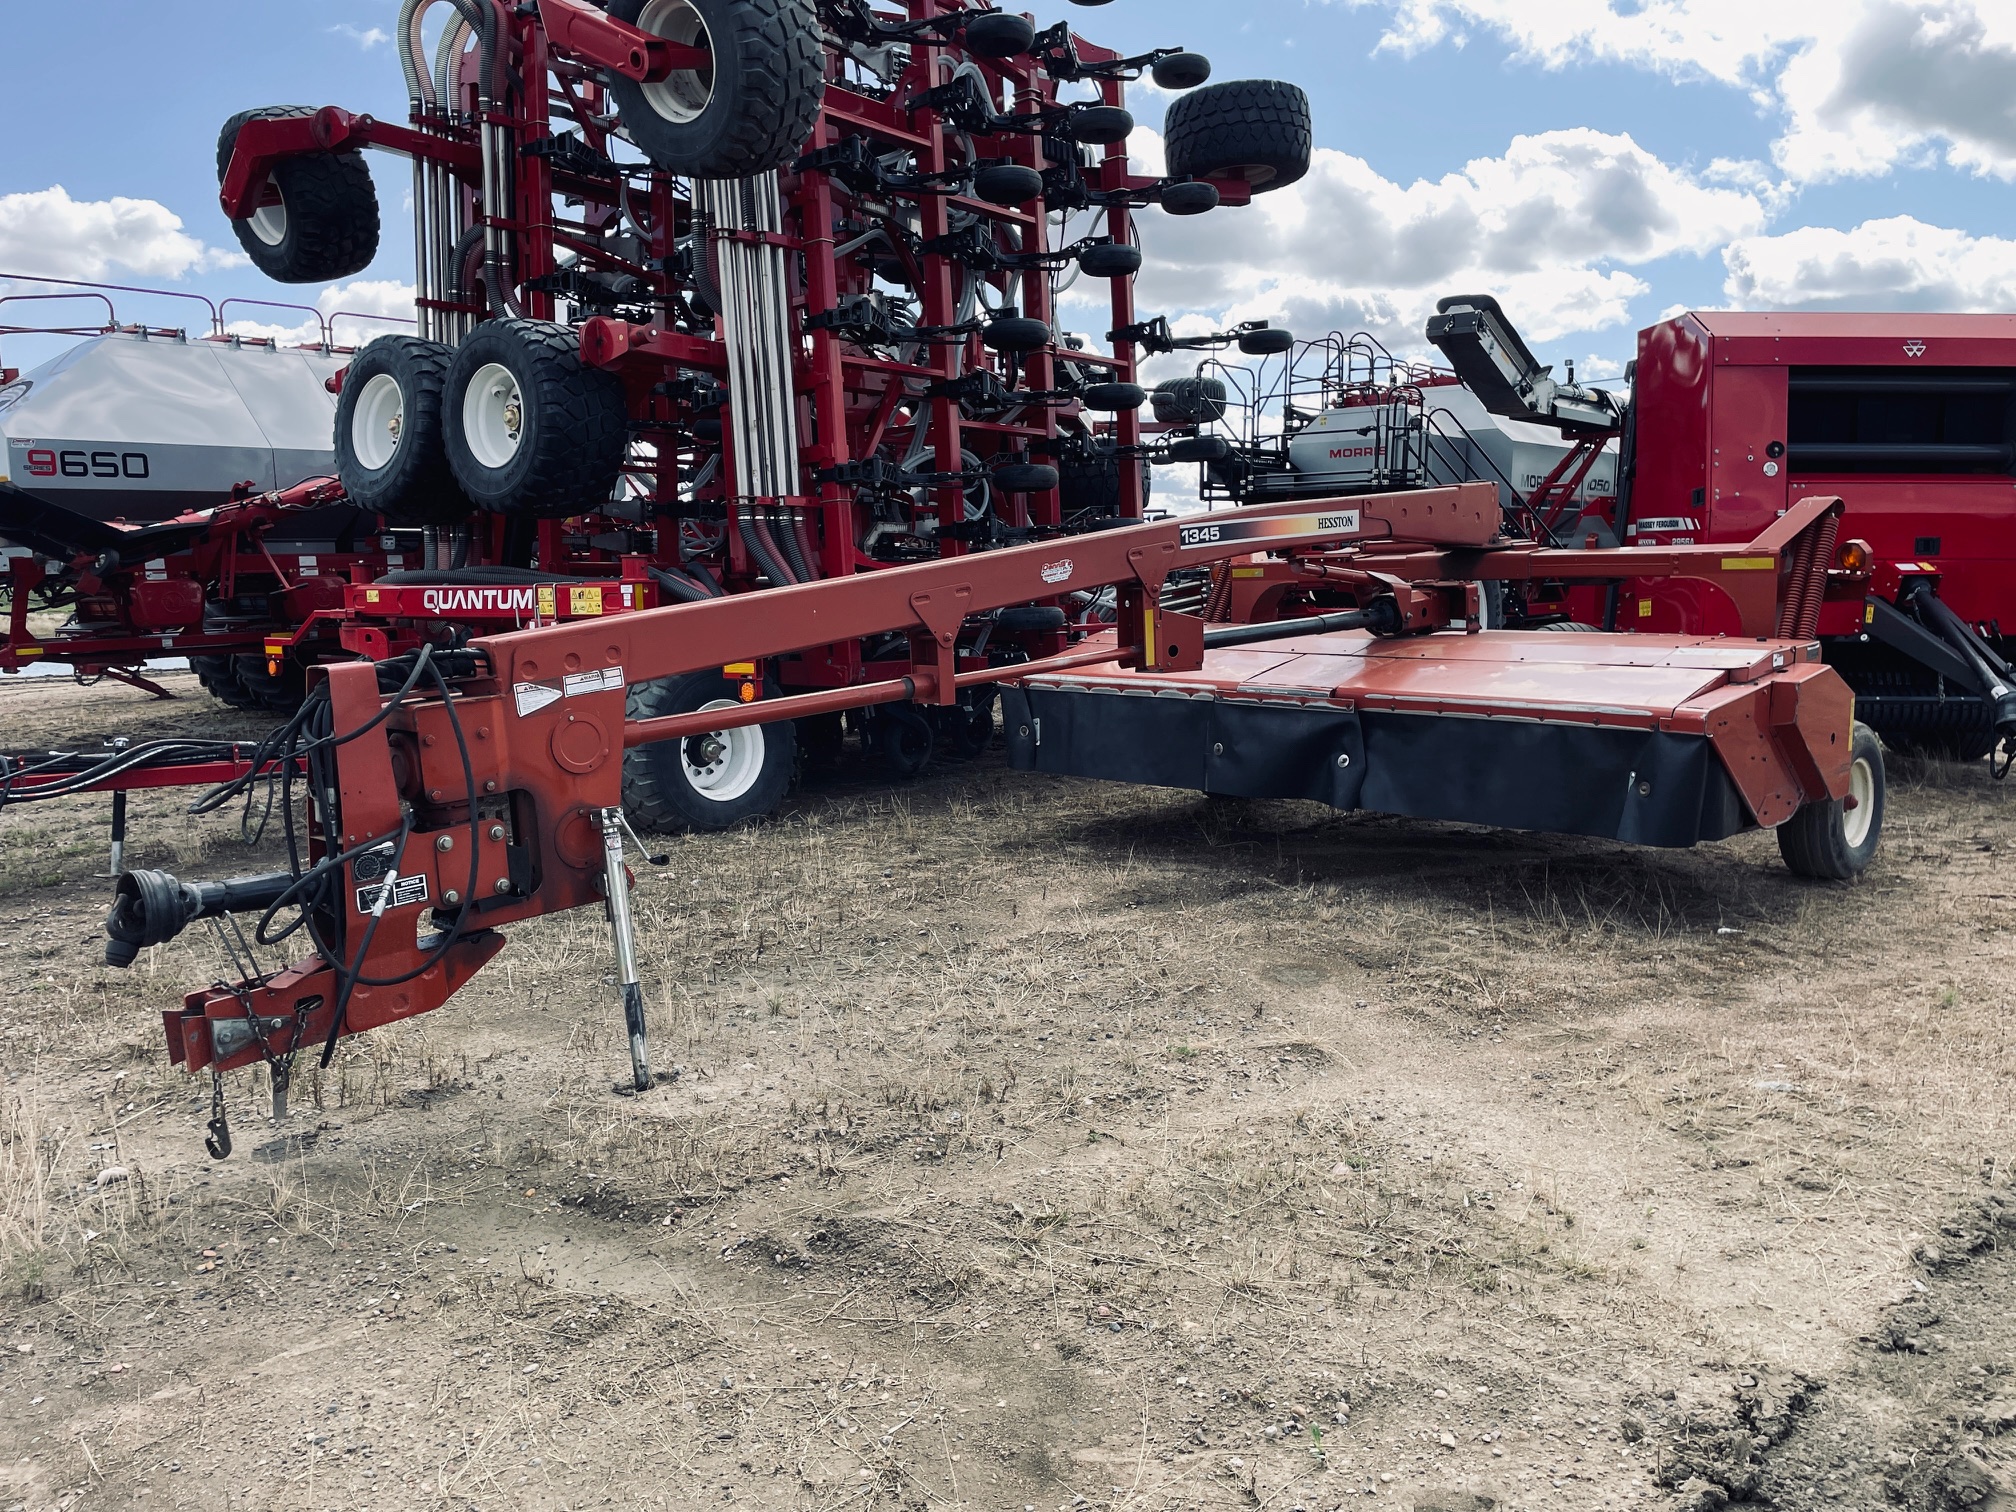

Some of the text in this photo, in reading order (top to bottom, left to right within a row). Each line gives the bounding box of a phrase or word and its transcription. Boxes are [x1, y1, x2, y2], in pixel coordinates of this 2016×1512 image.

[1318, 515, 1353, 530] HESSTON
[1638, 519, 1679, 529] MASSEY FERGUSON
[1181, 527, 1220, 544] 1345
[423, 589, 533, 614] QUANTUM
[400, 879, 420, 887] NOTICE
